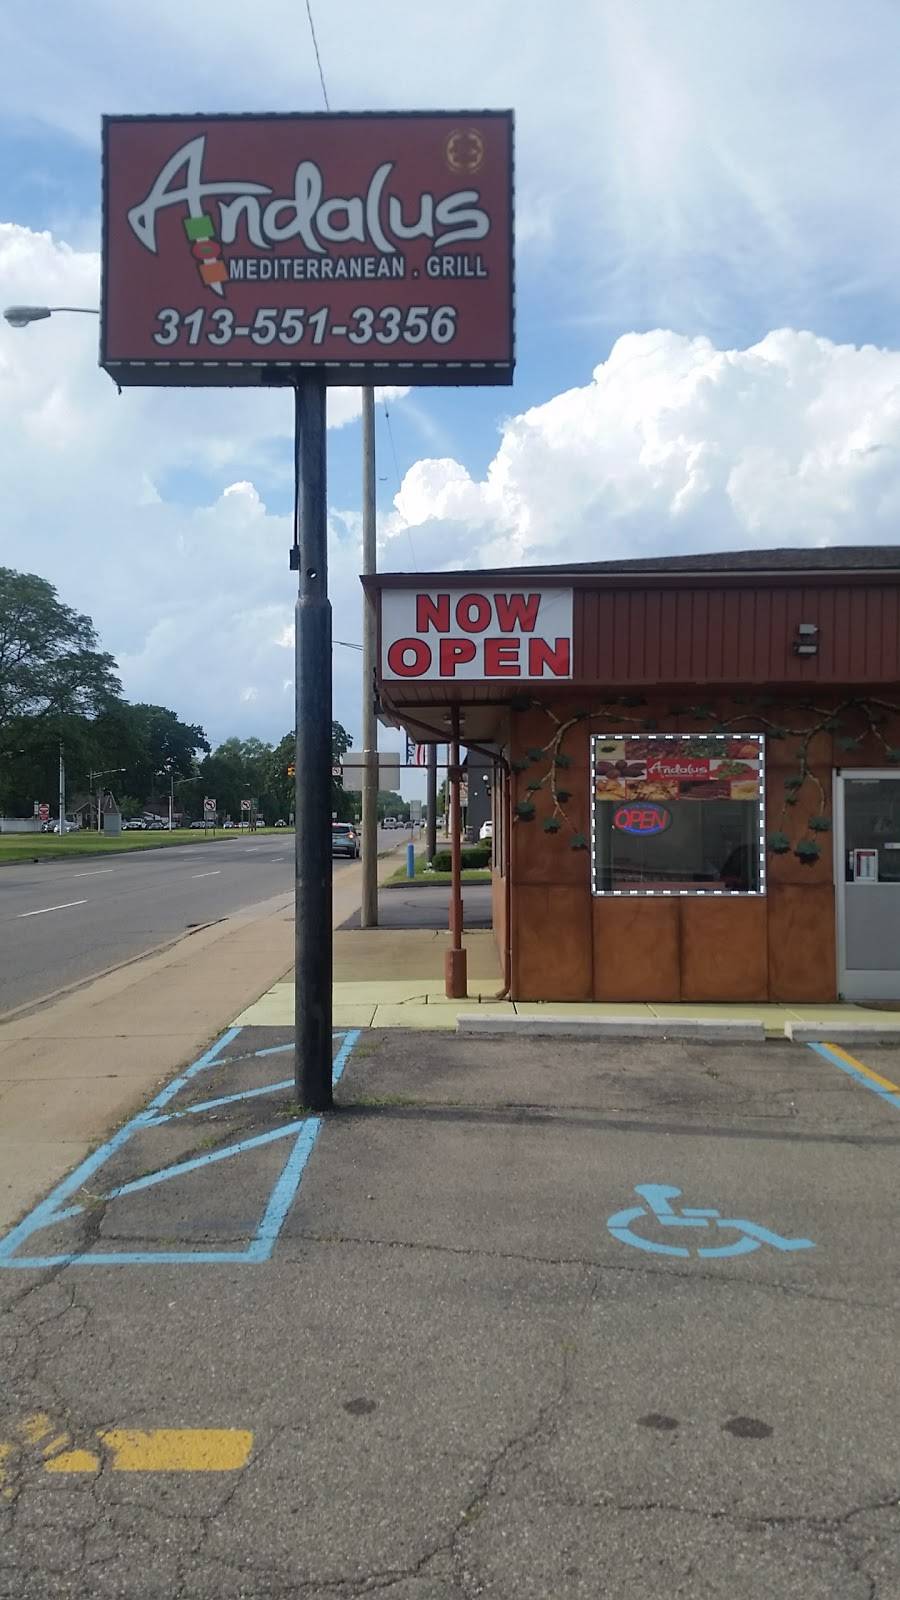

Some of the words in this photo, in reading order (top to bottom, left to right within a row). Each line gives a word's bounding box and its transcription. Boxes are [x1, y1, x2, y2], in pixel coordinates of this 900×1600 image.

[128, 135, 491, 256] Andalus
[229, 256, 405, 281] MEDITERRANEAN
[426, 255, 488, 279] GRILL
[153, 307, 457, 346] 313-551-3356
[416, 593, 542, 633] NOW
[387, 637, 571, 677] OPEN
[614, 810, 668, 829] OPEN
